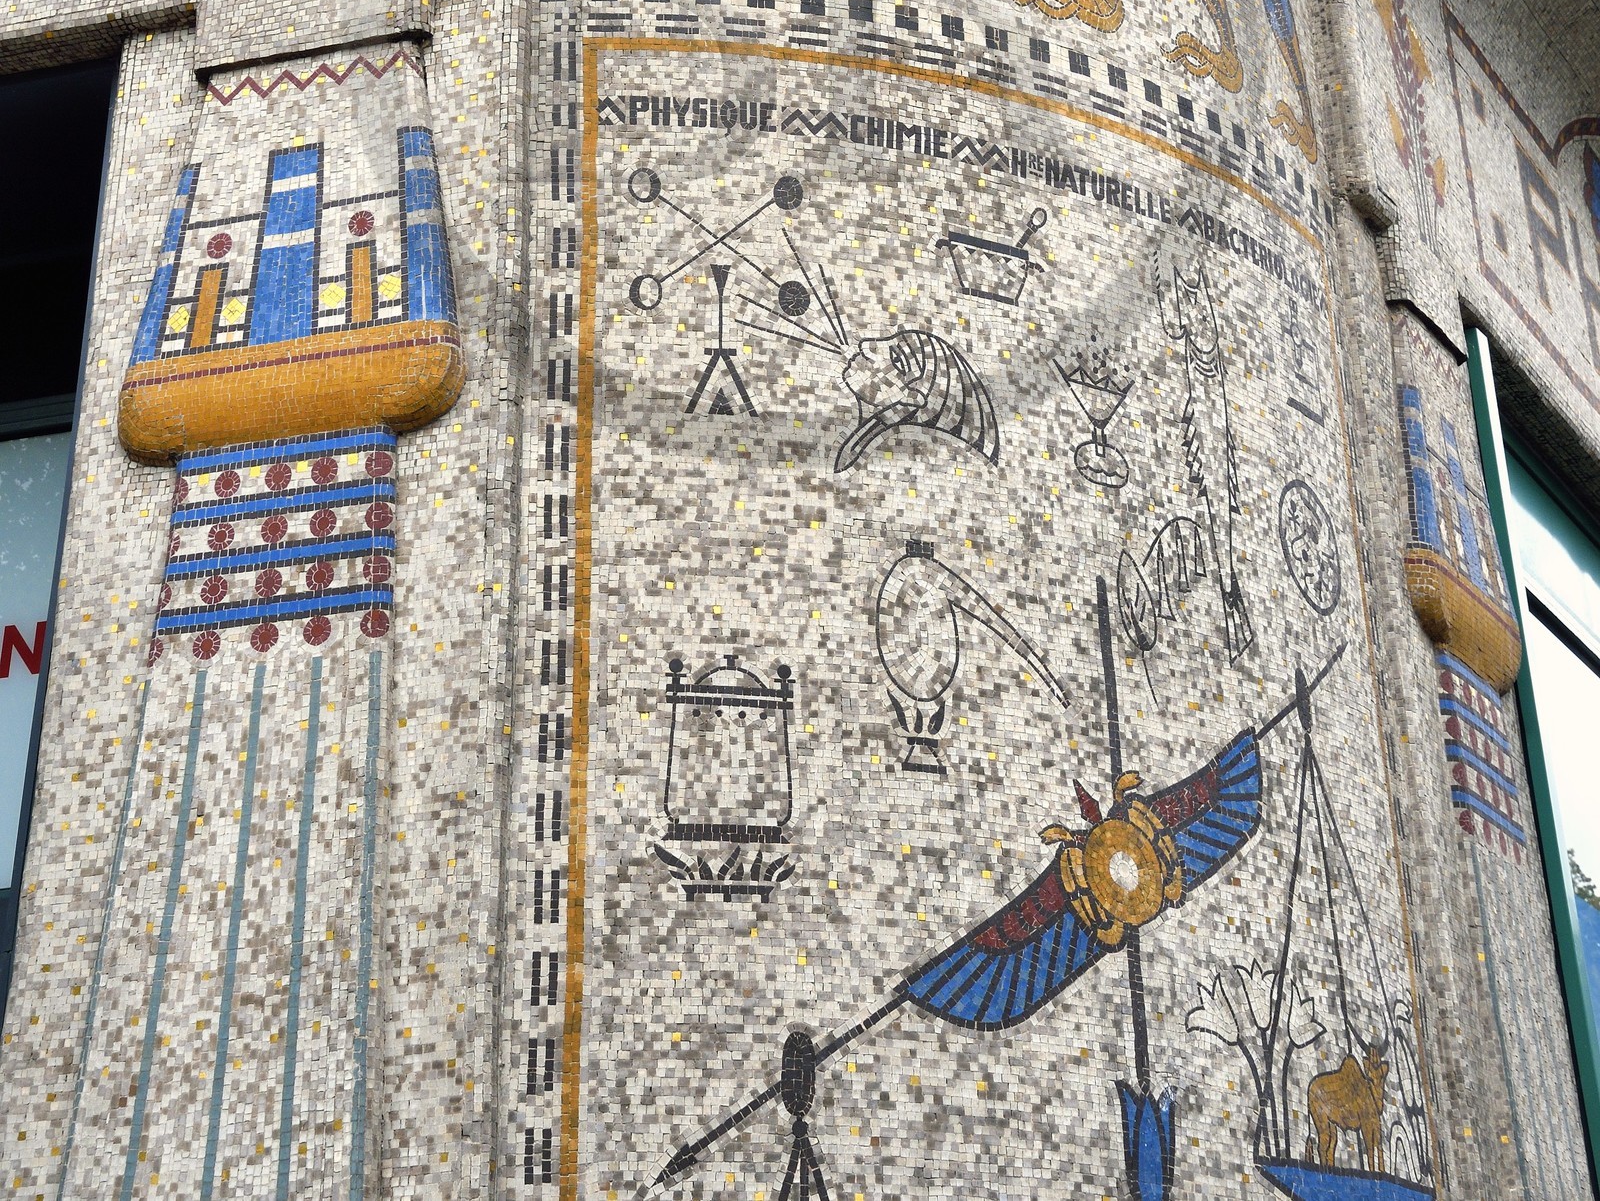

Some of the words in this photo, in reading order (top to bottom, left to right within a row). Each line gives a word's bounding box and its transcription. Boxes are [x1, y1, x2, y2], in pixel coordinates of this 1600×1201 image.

[629, 96, 777, 137] PHYSIQUE
[850, 114, 949, 159] CHIMIE
[1045, 159, 1172, 225] NATURELLE
